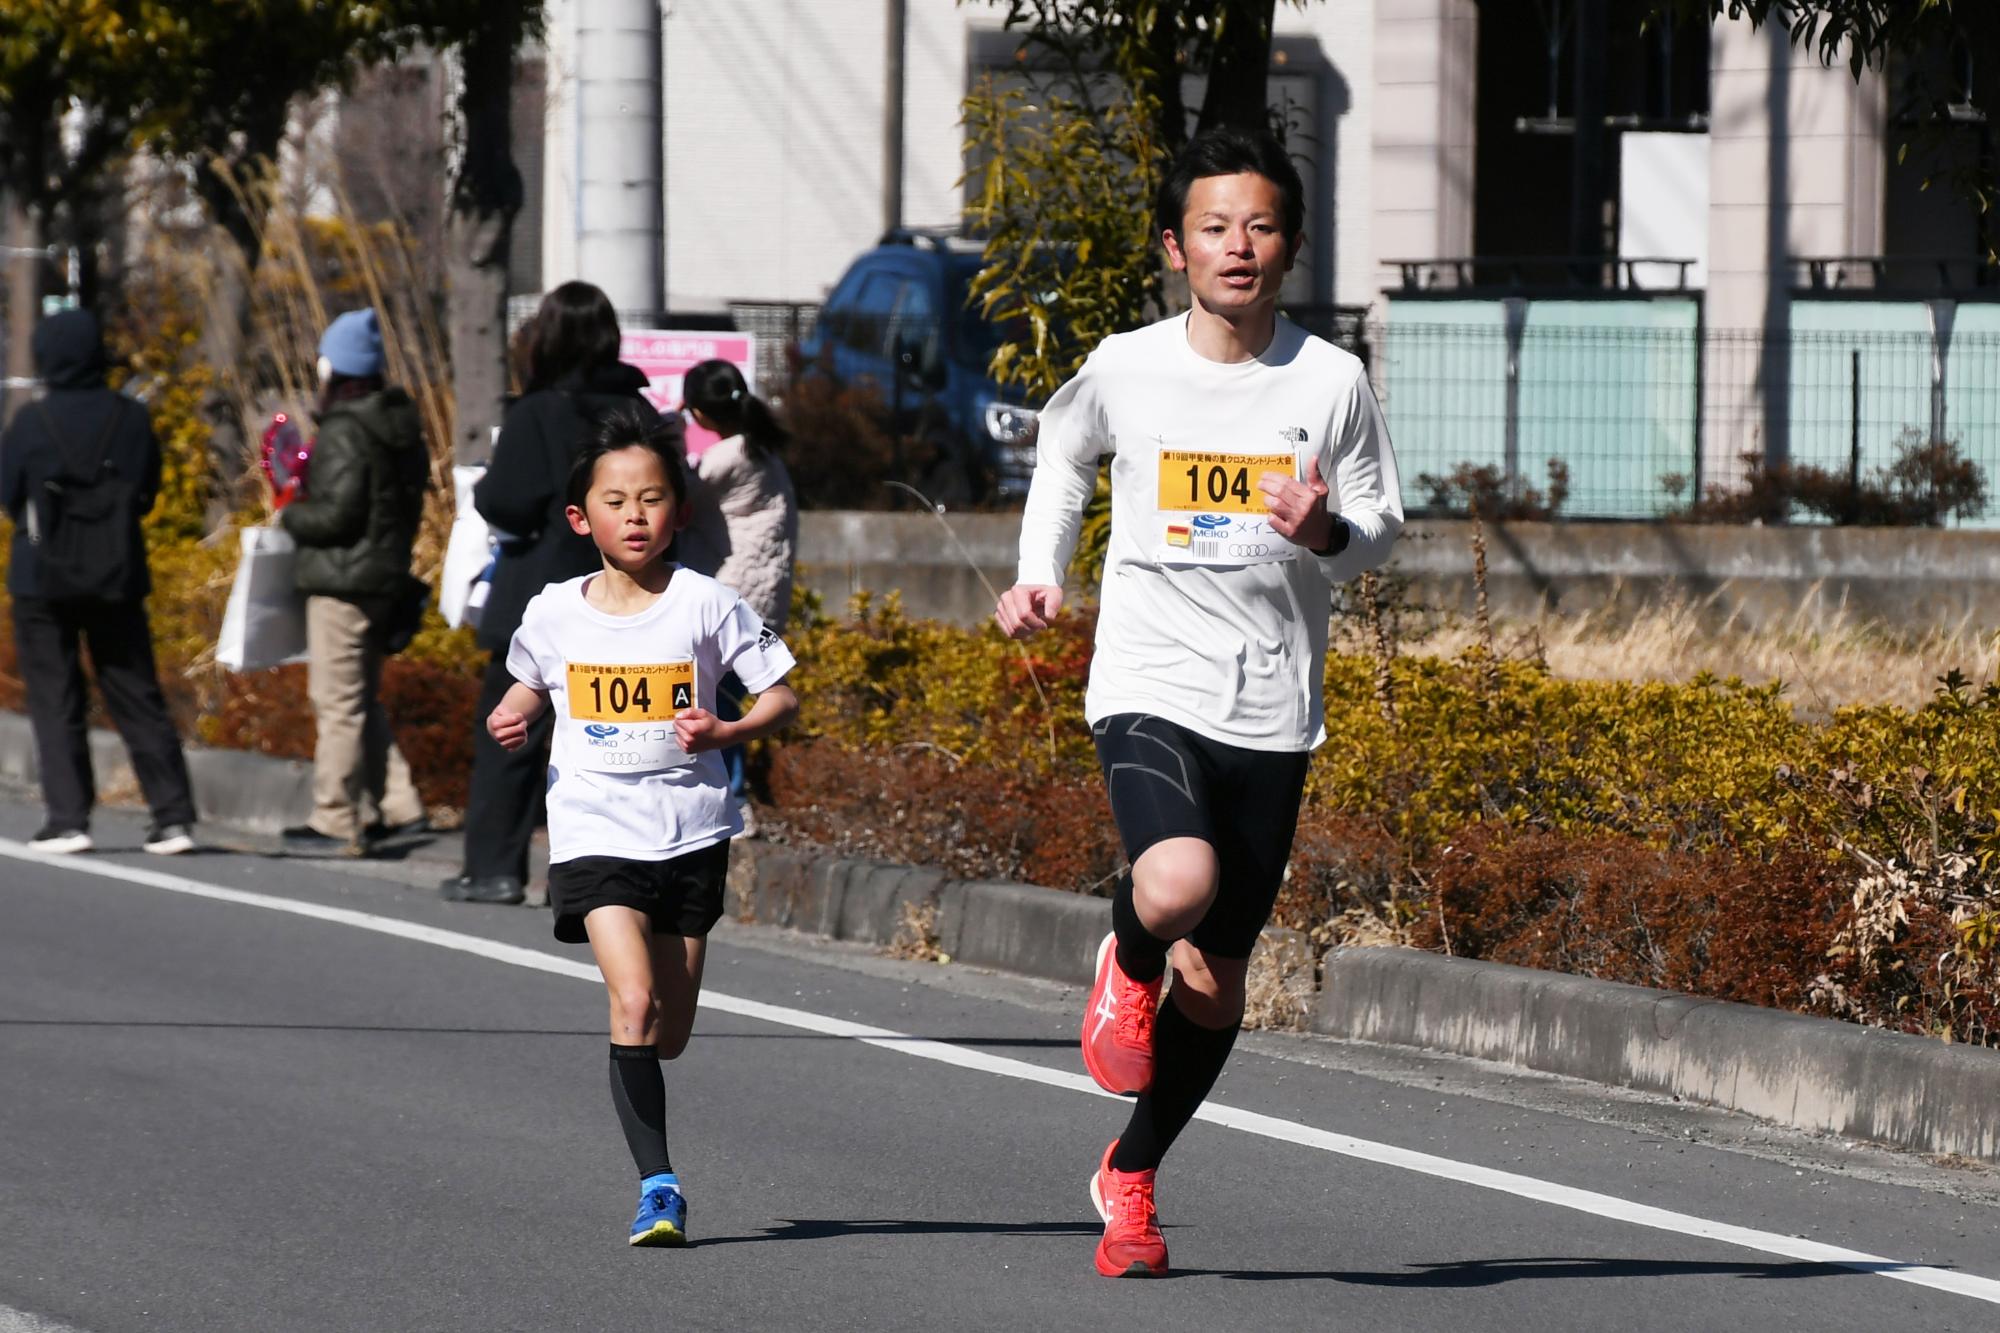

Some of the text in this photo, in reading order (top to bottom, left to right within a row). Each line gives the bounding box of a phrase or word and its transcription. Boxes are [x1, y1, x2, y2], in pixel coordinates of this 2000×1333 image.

[1186, 464, 1251, 504] 104
[1194, 529, 1229, 539] MEIKO
[590, 677, 690, 714] 104 A
[588, 739, 618, 749] MEIKO
